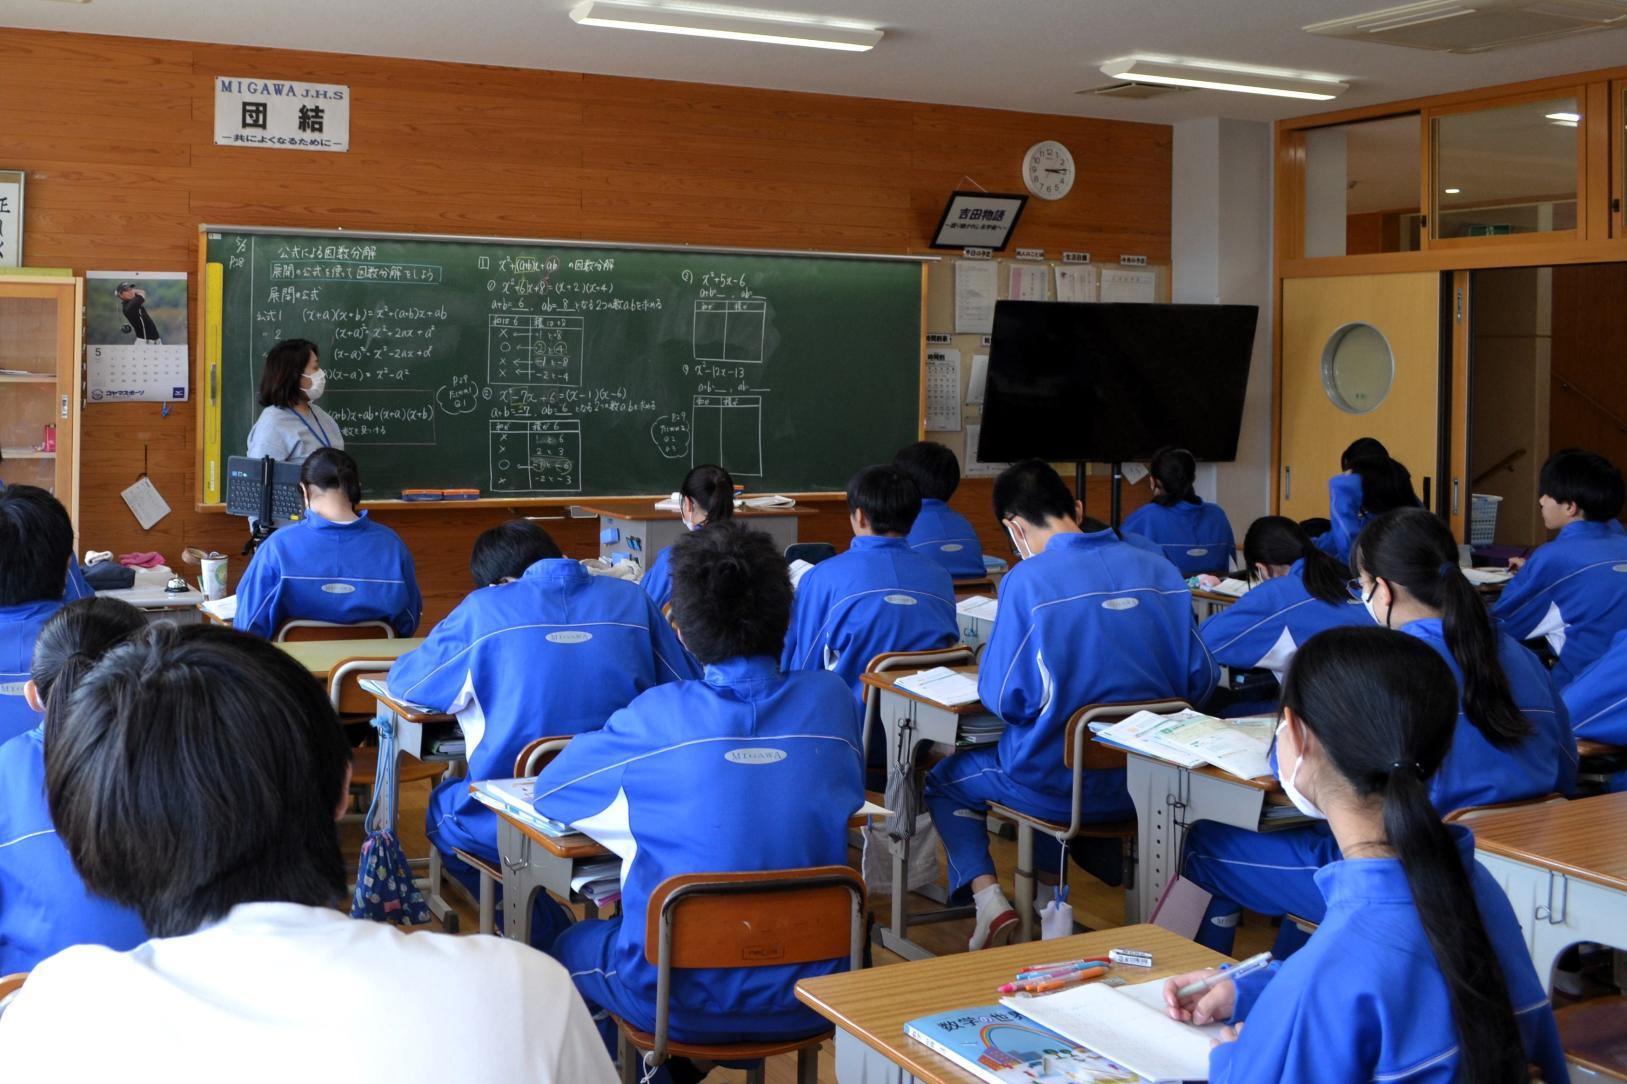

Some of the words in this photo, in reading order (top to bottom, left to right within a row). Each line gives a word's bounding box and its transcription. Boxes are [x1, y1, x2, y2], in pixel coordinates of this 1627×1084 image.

[221, 80, 297, 97] MIGAWA
[278, 245, 376, 260] 公式による因数分解
[95, 347, 102, 357] 5
